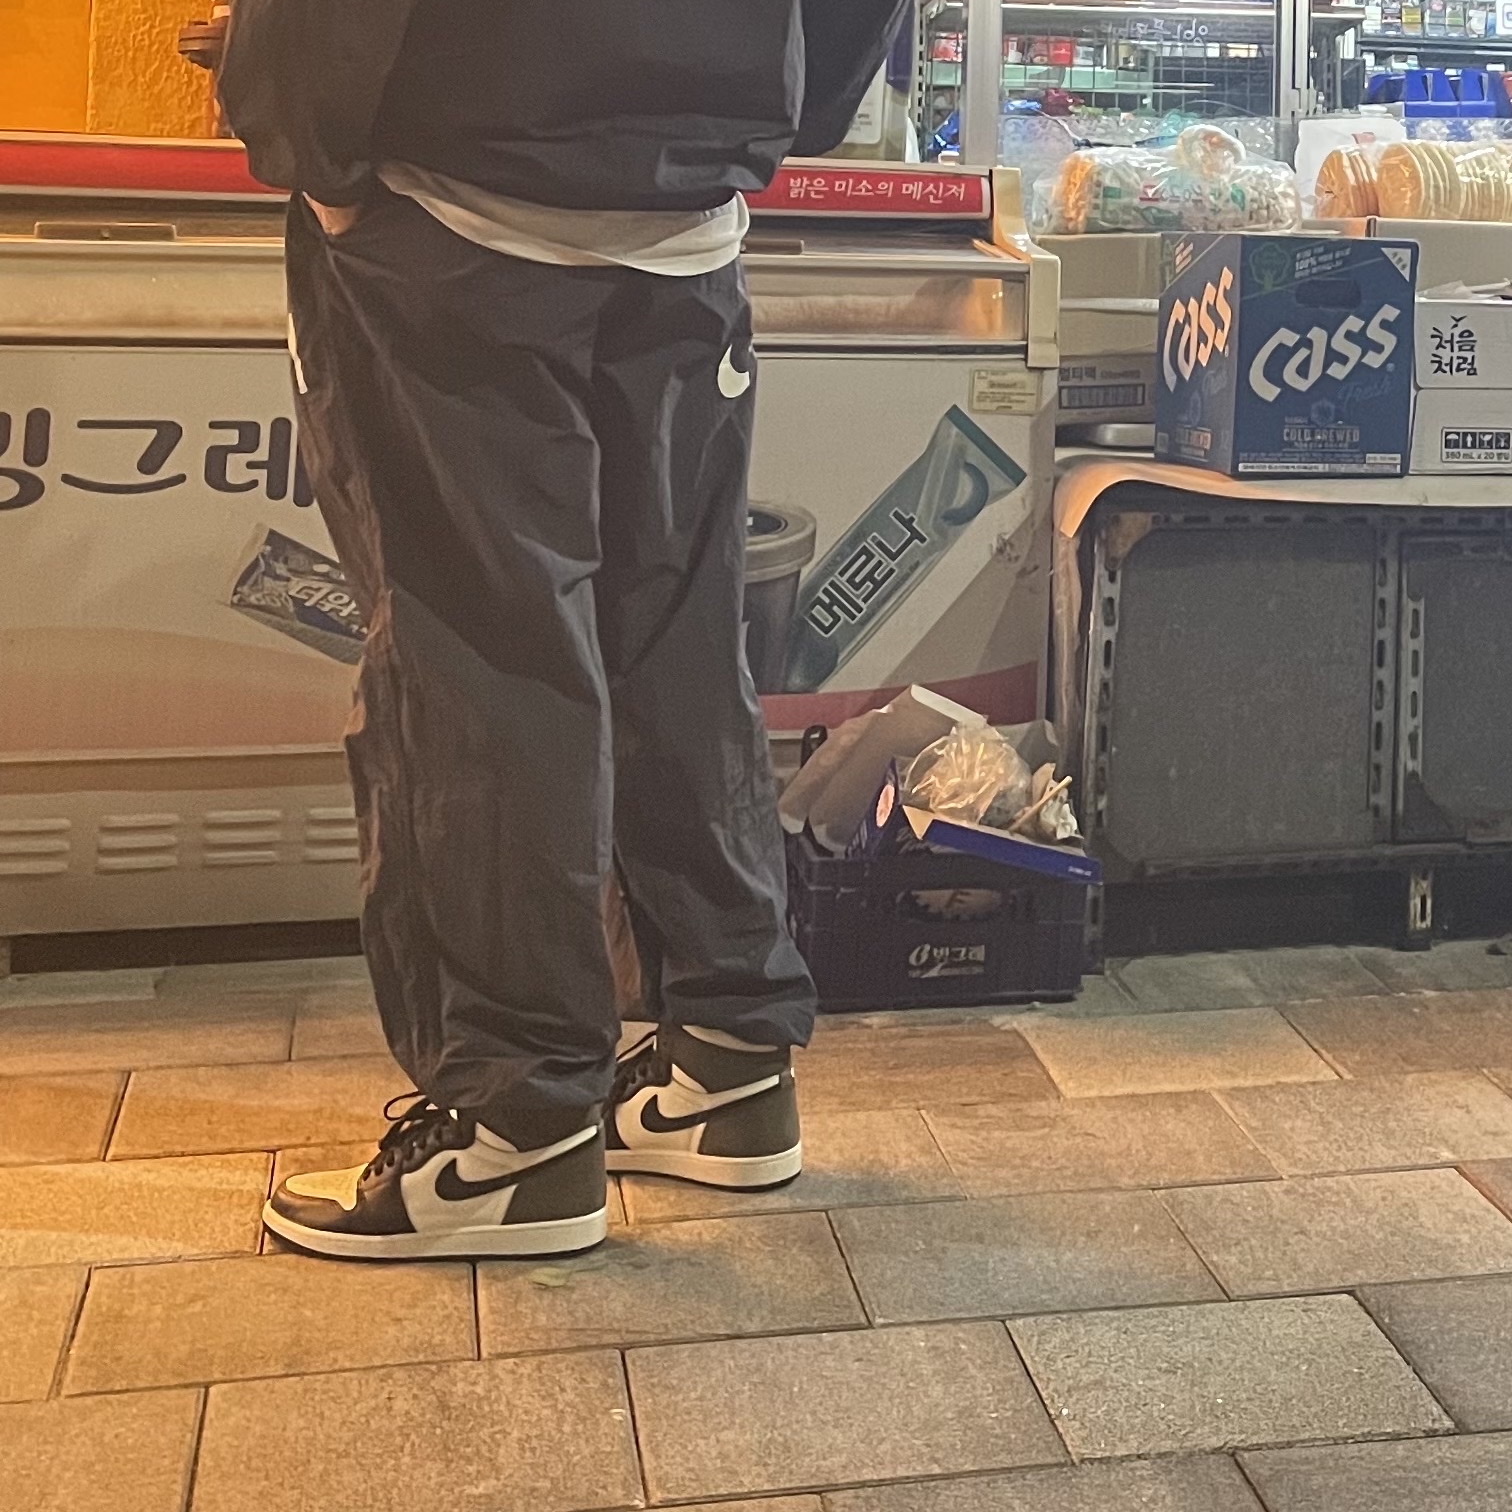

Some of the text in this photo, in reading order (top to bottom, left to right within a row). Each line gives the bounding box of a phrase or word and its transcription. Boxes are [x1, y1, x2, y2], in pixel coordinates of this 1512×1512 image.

[788, 177, 966, 204] 밝은 미소의 메신저
[1430, 327, 1478, 353] 처음
[1430, 353, 1478, 376] 처럼
[803, 506, 929, 638] 메로나
